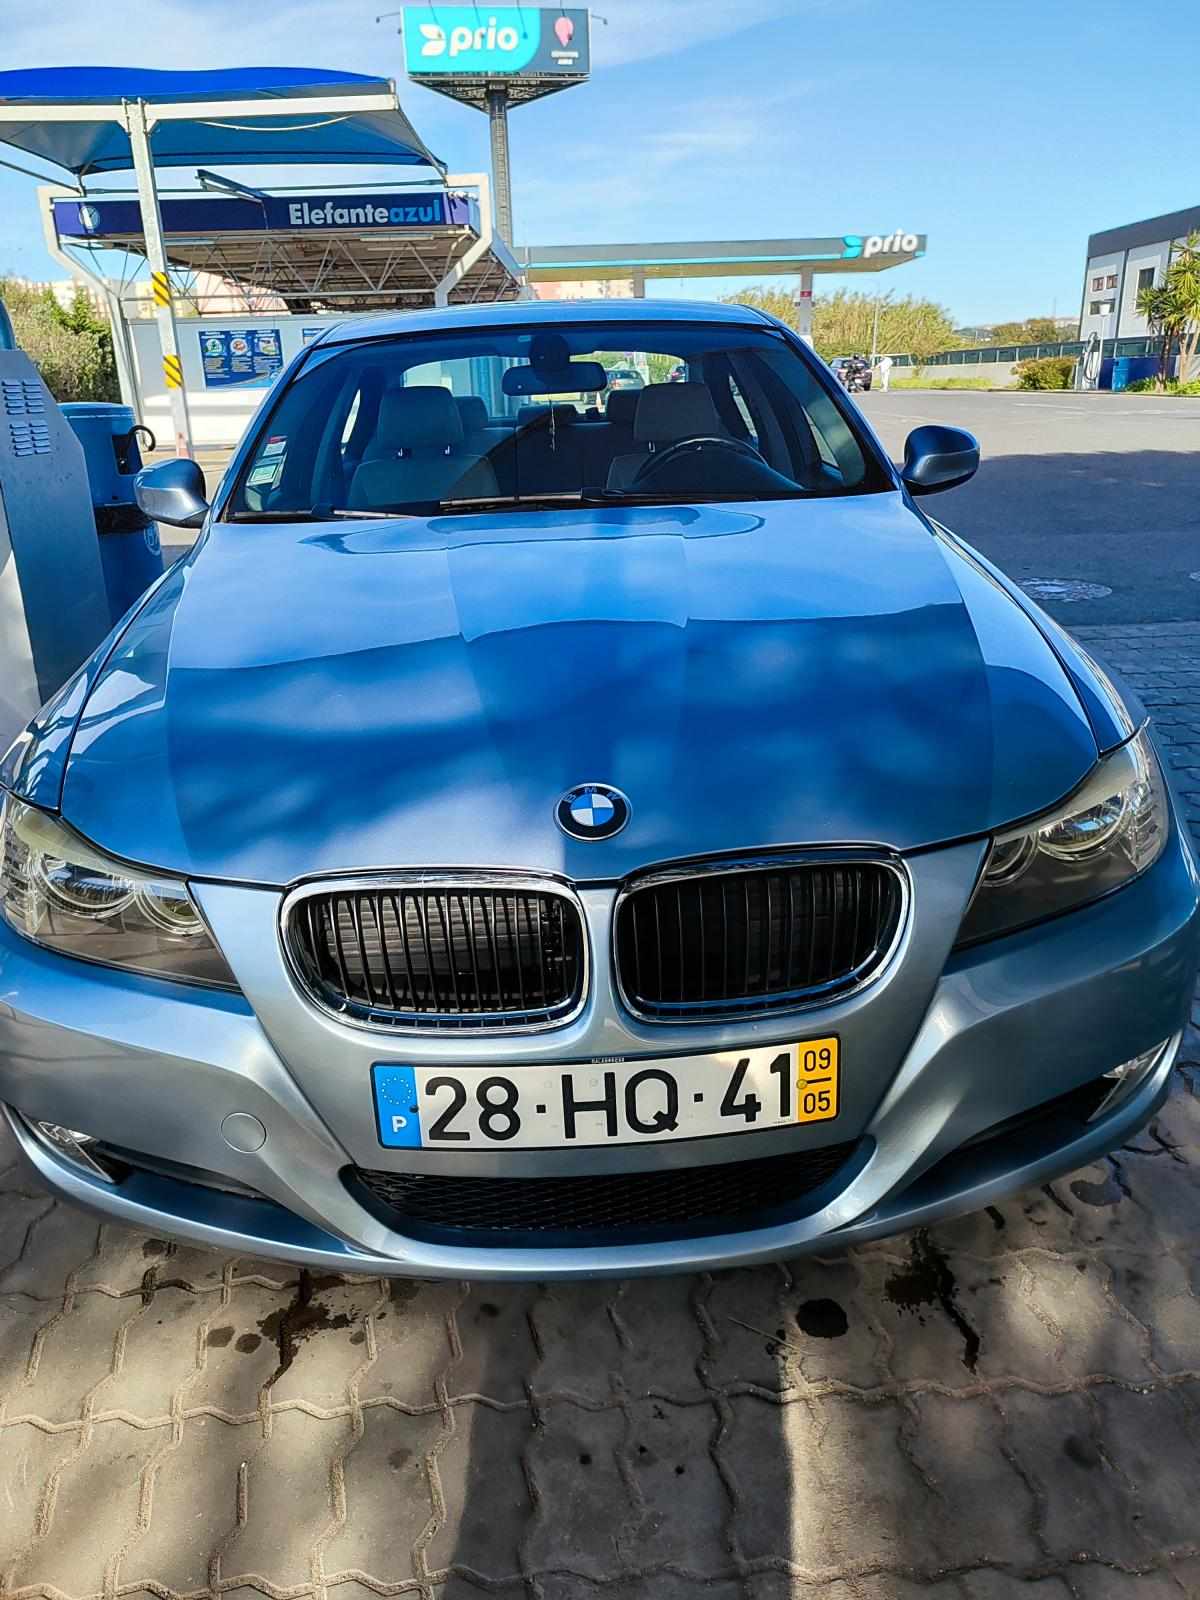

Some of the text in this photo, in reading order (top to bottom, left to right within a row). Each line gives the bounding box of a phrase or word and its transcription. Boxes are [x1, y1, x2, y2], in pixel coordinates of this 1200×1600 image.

[448, 16, 519, 57] prio
[863, 228, 918, 258] prio
[803, 1048, 831, 1072] 09
[803, 1090, 831, 1114] 05
[391, 1115, 408, 1133] P
